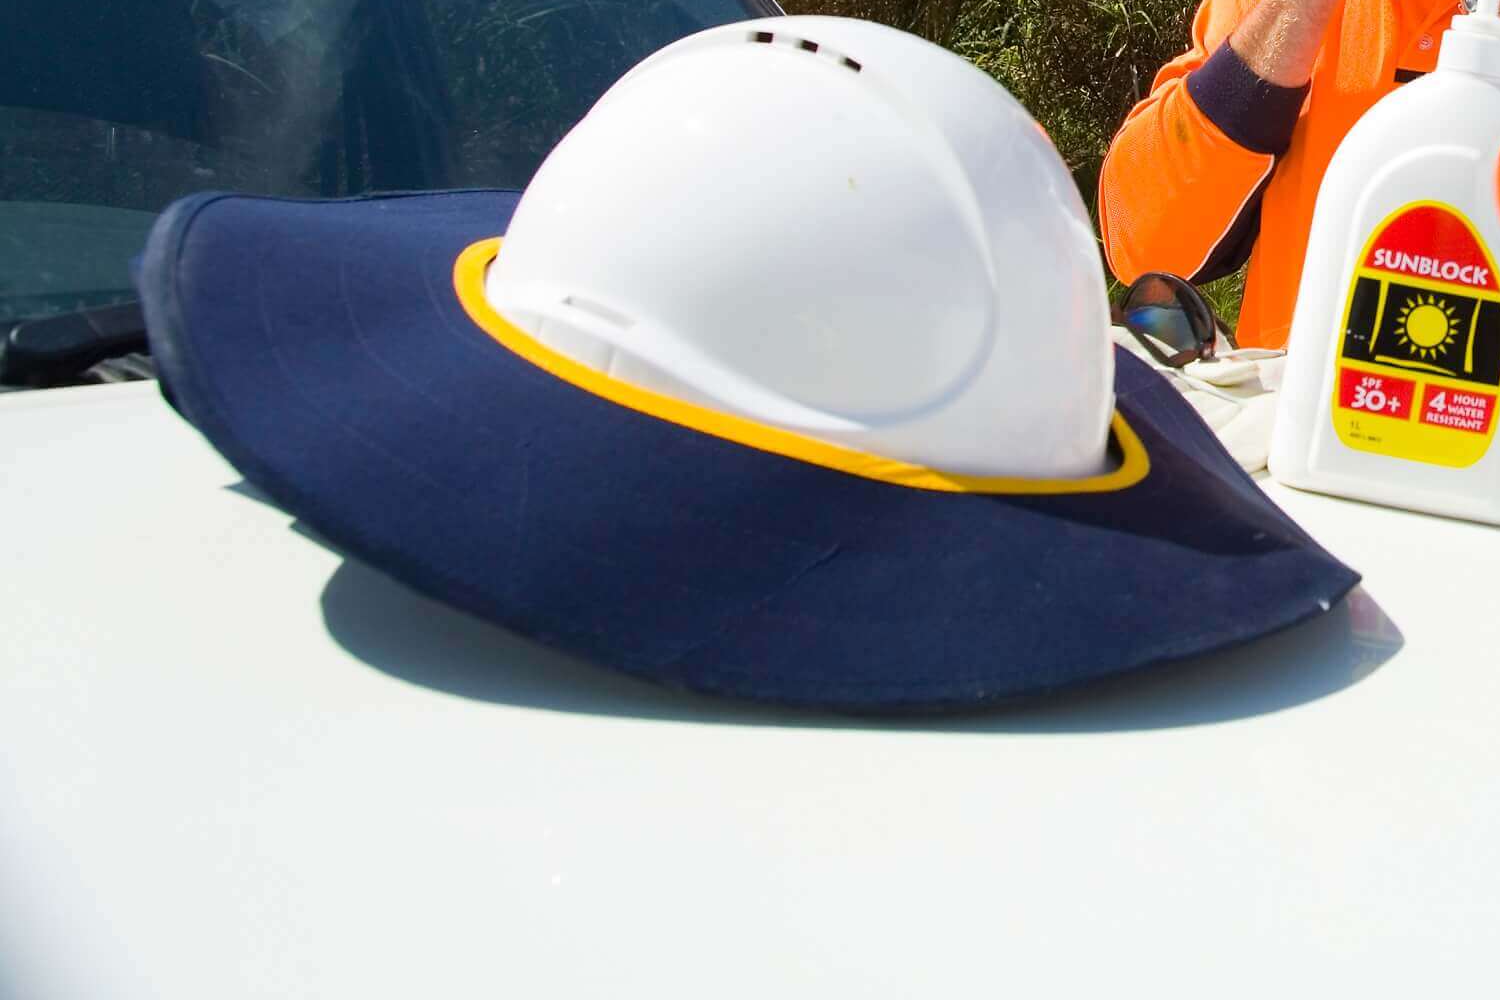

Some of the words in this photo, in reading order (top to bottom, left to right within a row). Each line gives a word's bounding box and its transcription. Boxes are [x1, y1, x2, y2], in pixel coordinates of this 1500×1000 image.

[1374, 248, 1488, 285] SUNBLOCK
[1361, 376, 1382, 389] SPF
[1351, 385, 1401, 413] 30+
[1429, 391, 1447, 413] 4
[1453, 394, 1487, 409] HOUR
[1426, 412, 1483, 430] RESISTANT
[1447, 403, 1485, 420] WATER
